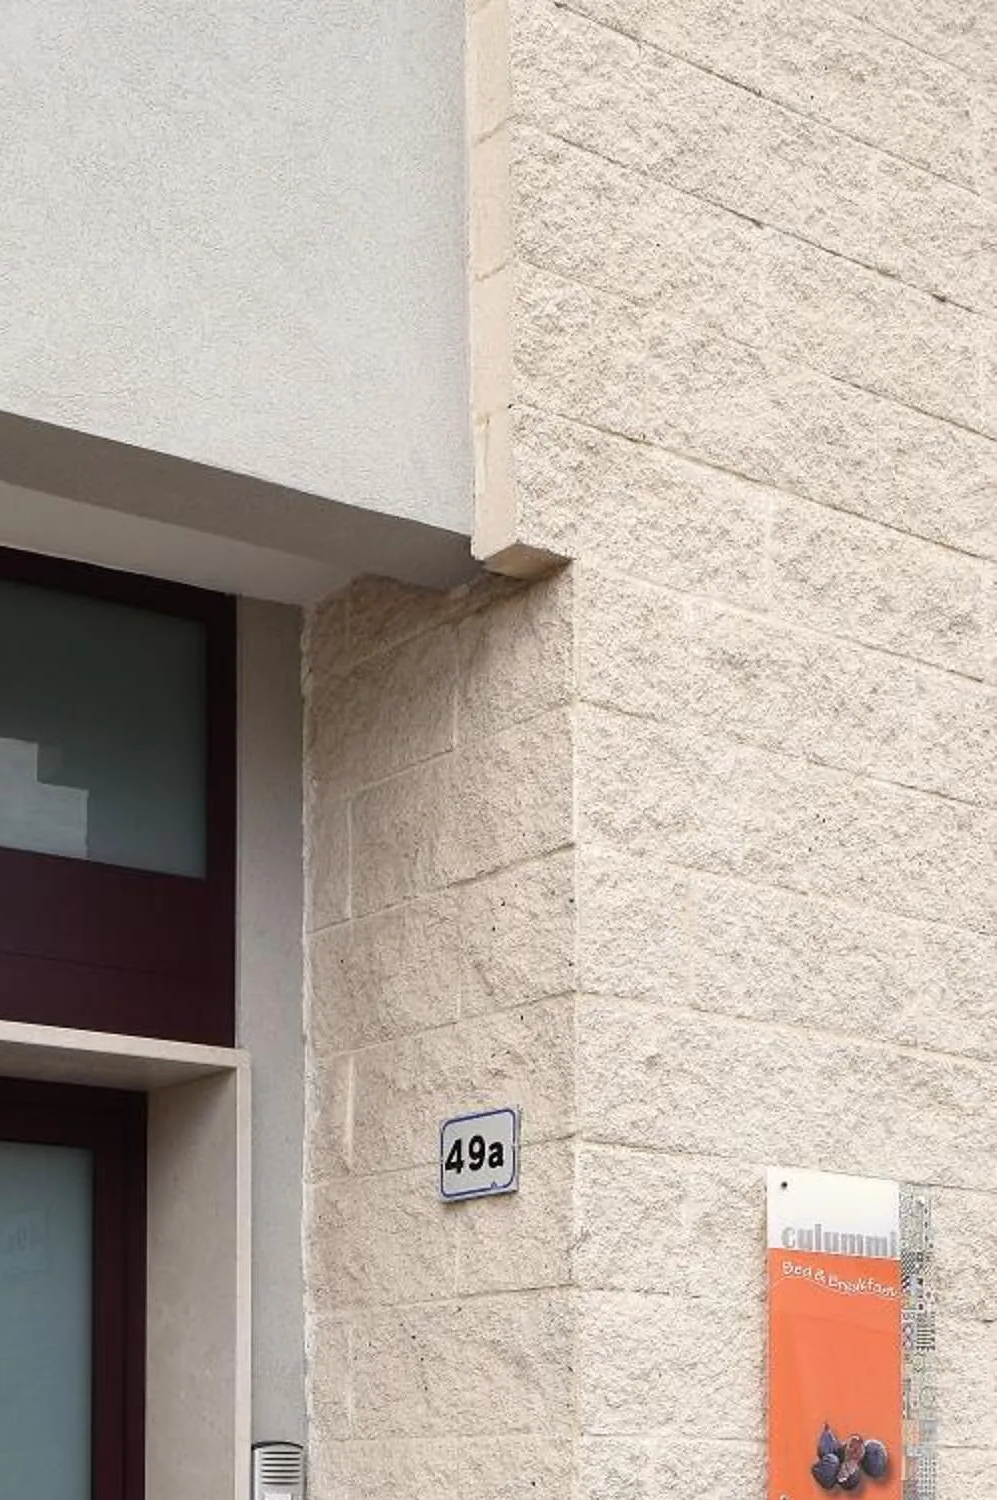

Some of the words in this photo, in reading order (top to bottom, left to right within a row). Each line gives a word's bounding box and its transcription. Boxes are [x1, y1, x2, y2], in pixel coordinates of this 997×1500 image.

[445, 1135, 504, 1174] 49a
[782, 1261, 811, 1277] Bed
[814, 1268, 826, 1284] &
